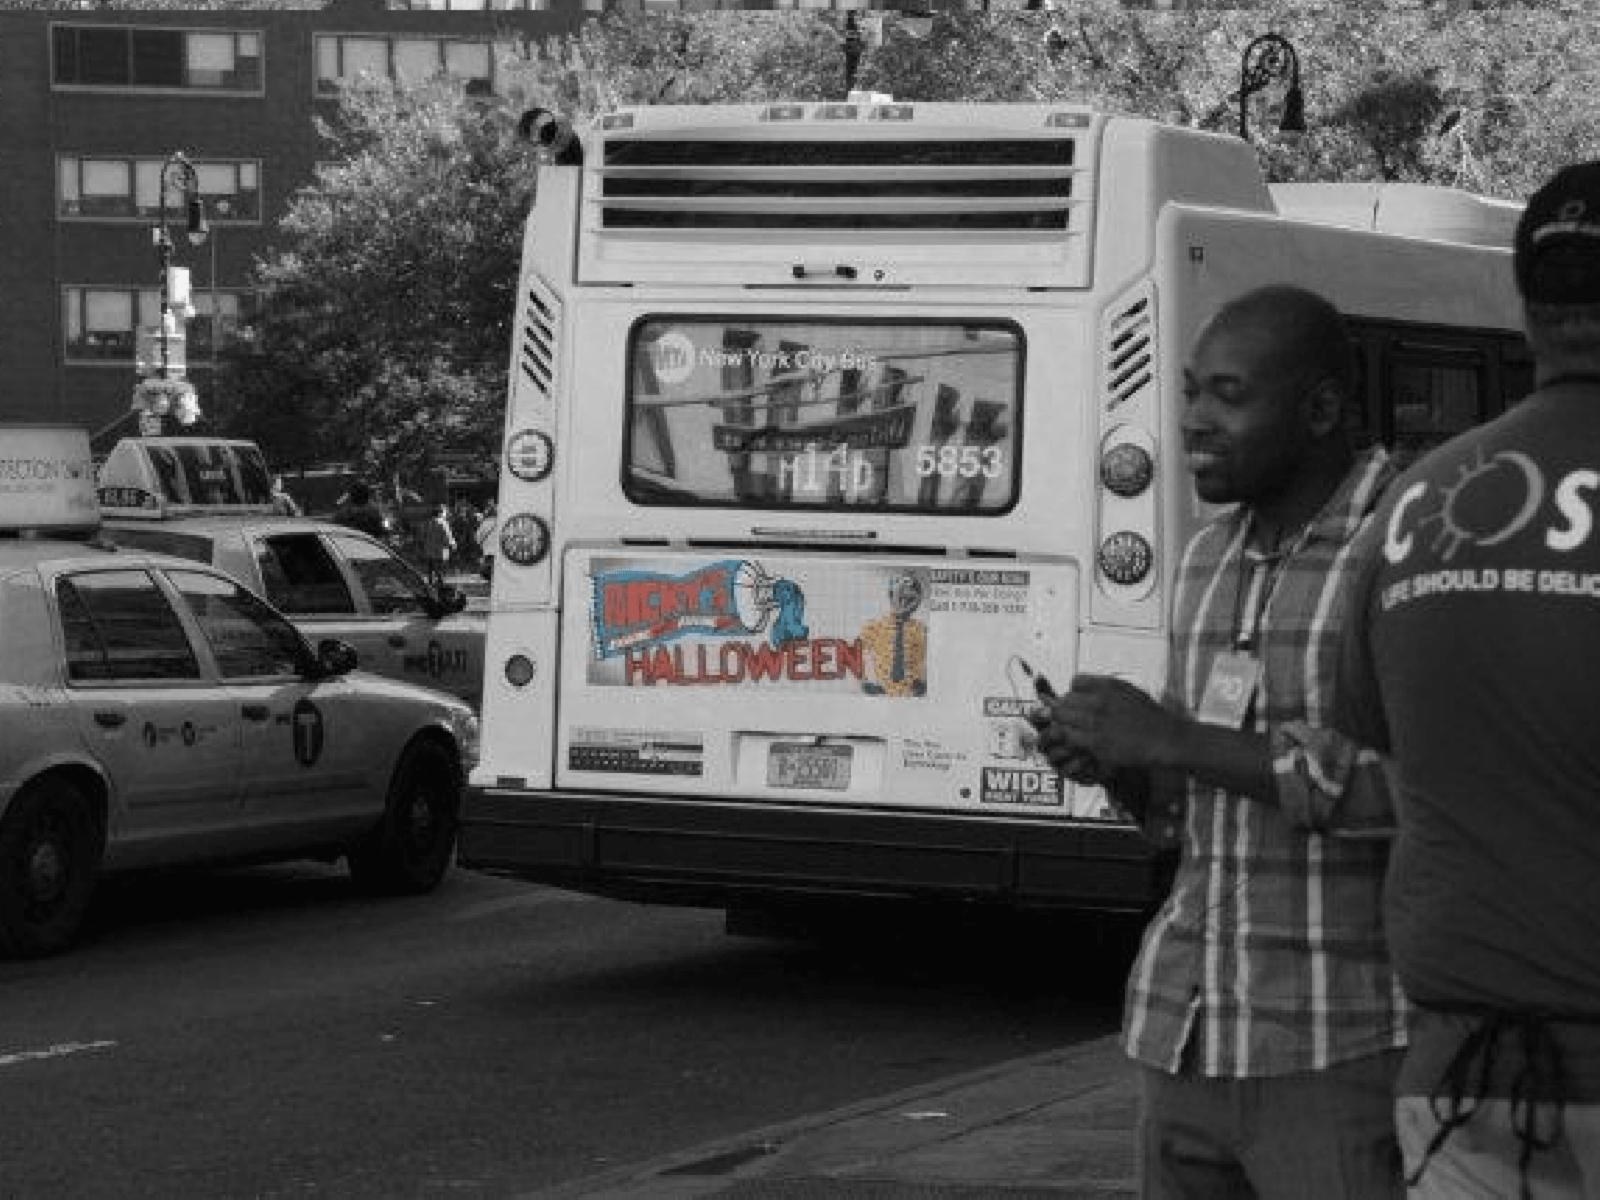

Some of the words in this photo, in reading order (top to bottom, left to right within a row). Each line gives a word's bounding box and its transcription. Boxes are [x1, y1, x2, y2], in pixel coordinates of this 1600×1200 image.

[699, 348, 743, 367] New
[748, 348, 791, 369] York
[794, 350, 836, 375] City
[916, 445, 1003, 478] 5853
[1504, 568, 1537, 592] BE
[625, 638, 865, 686] HALLOWEEN
[987, 768, 1060, 793] WIDE
